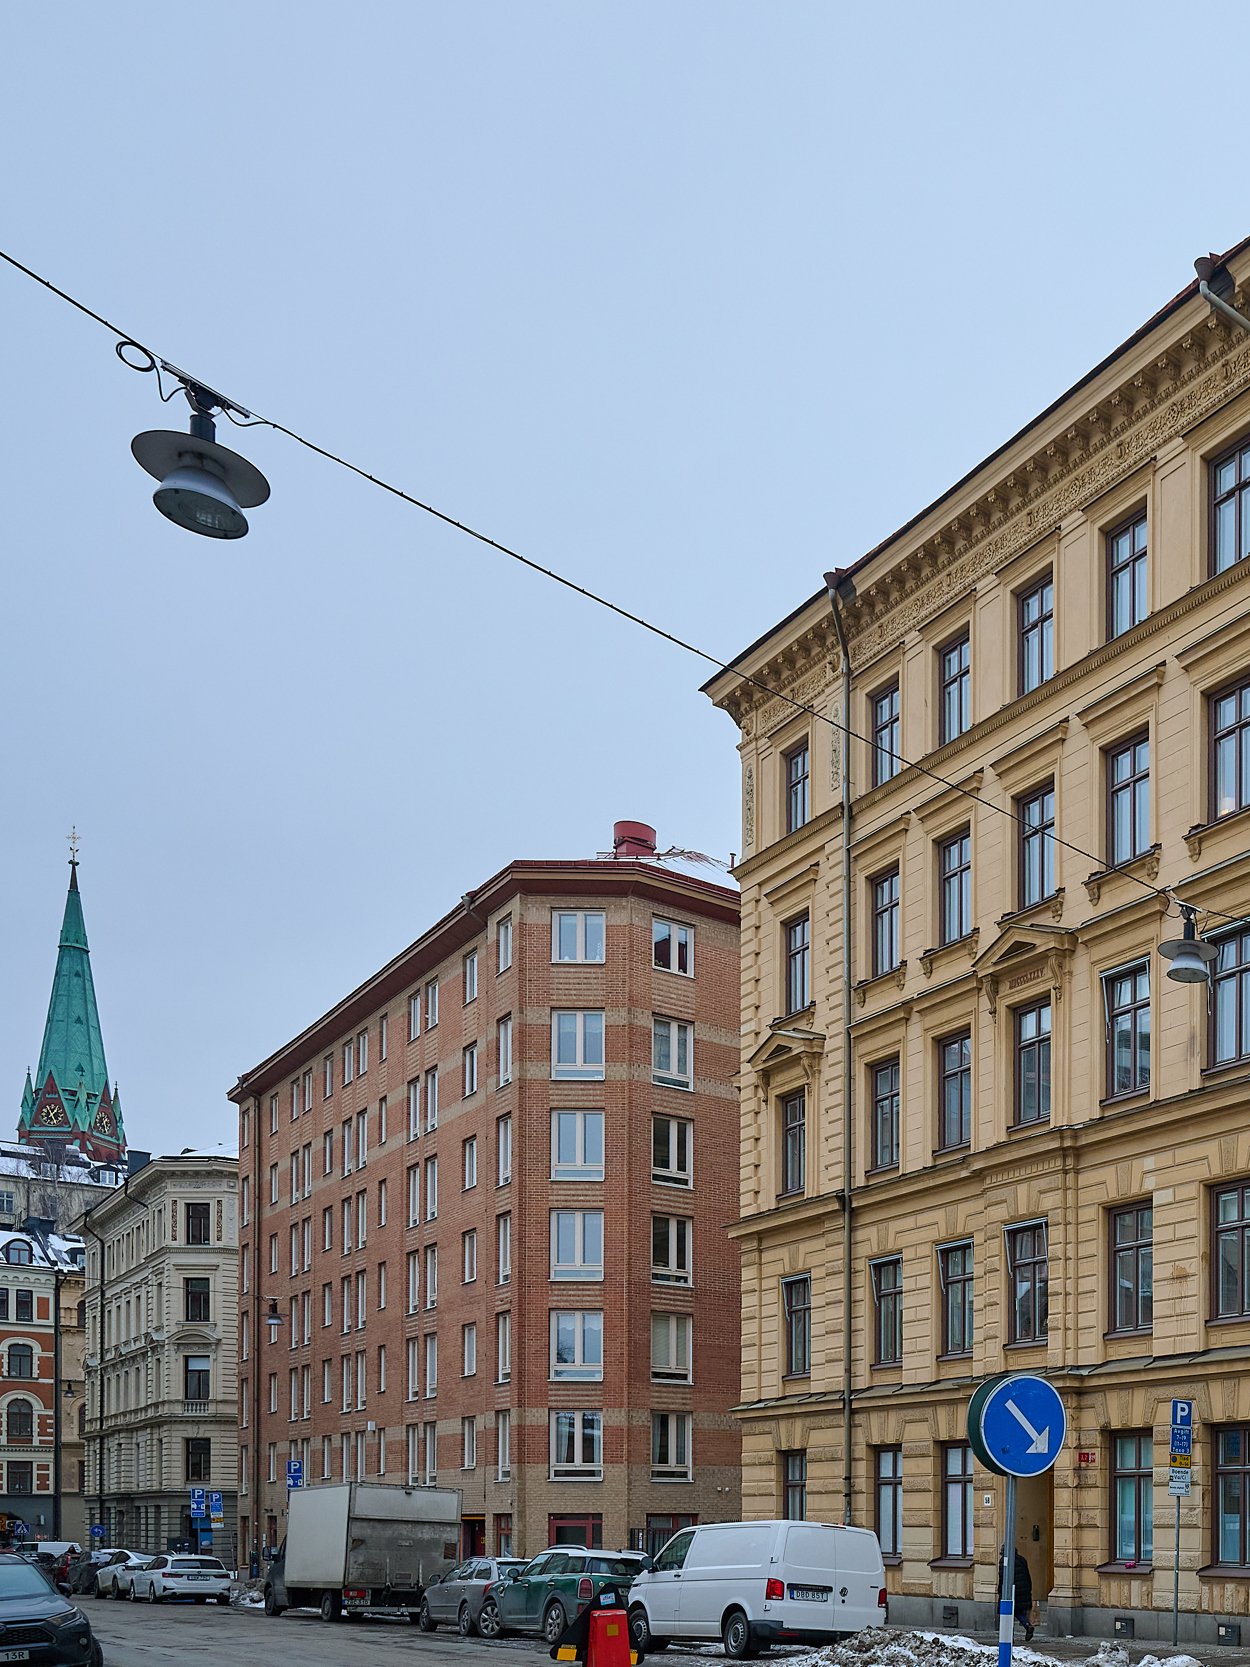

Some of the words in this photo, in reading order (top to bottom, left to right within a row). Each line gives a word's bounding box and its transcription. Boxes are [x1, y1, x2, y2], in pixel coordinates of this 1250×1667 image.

[1176, 1402, 1189, 1424] P
[291, 1462, 300, 1473] P
[194, 1489, 203, 1499] P
[212, 1493, 220, 1502] P
[796, 1590, 810, 1599] DBD
[5, 1651, 25, 1661] 13R
